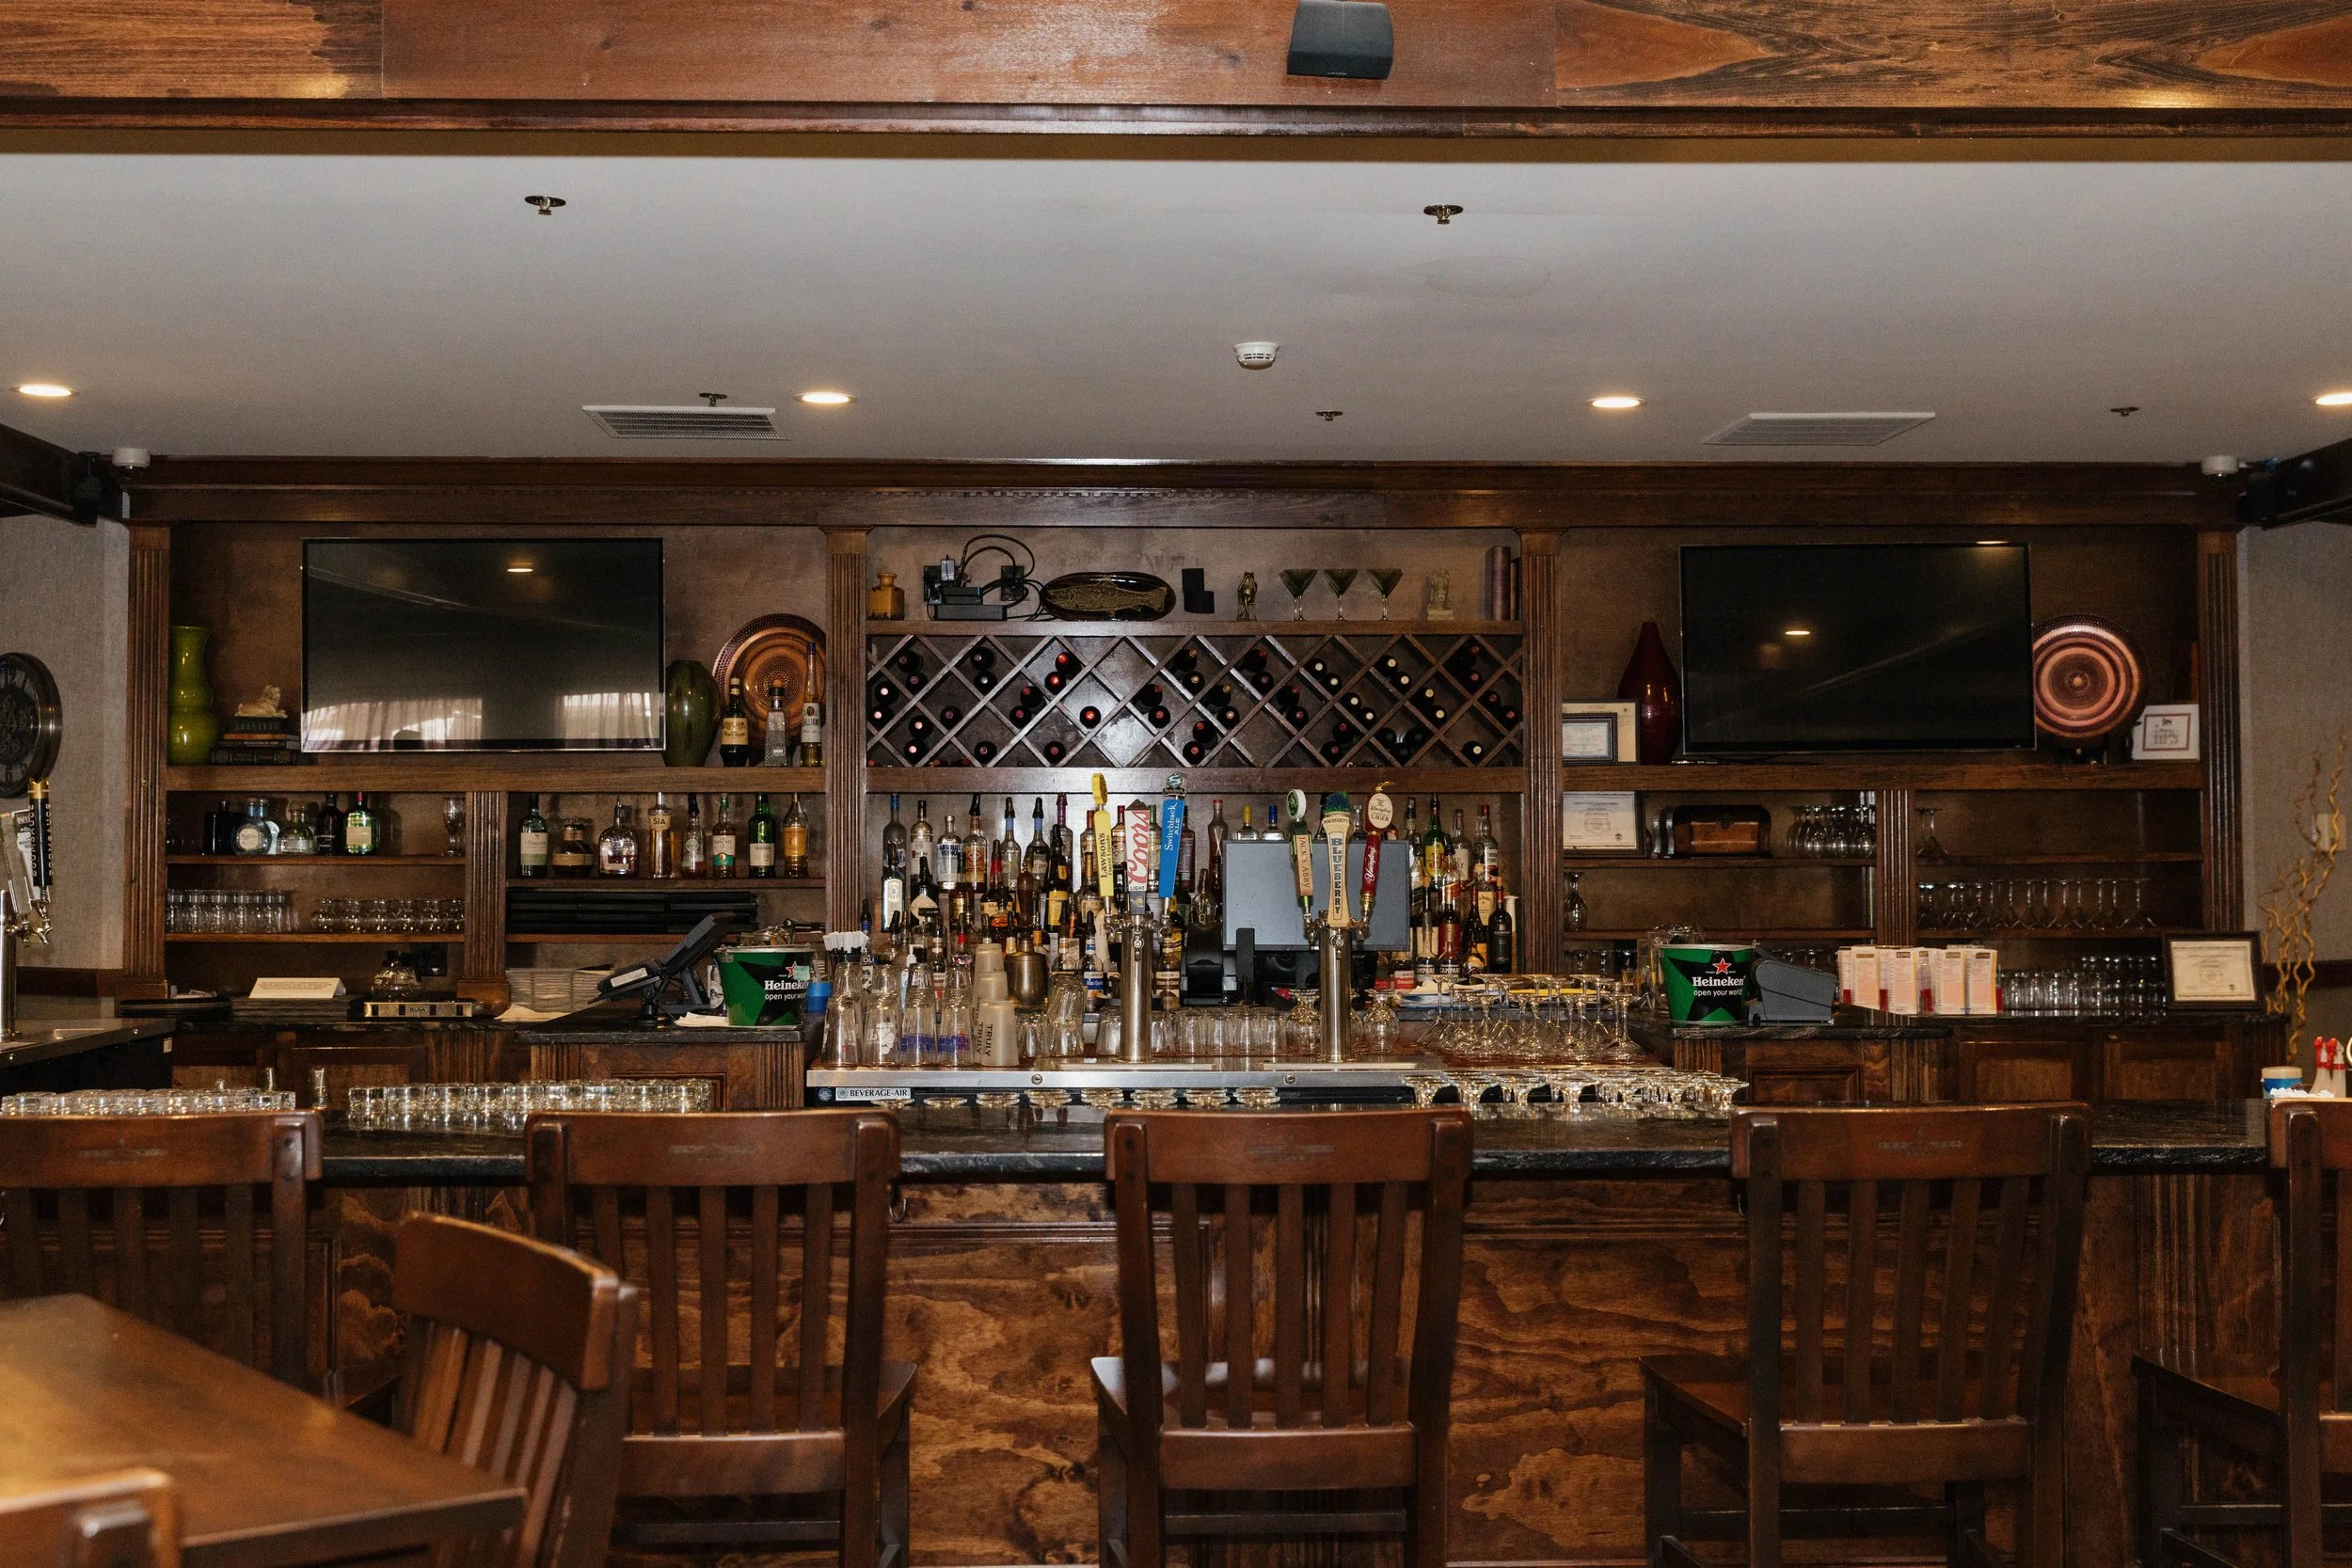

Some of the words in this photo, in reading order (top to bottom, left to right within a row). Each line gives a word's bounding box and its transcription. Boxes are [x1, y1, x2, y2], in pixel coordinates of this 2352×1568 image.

[1164, 801, 1178, 851] Switchback
[1098, 832, 1108, 879] Lawson's
[1127, 810, 1150, 884] Coors
[1297, 836, 1309, 863] JACK'S
[1301, 865, 1311, 889] ABBY
[1330, 837, 1343, 914] BLUEBERRY
[1692, 976, 1744, 987] Heineken
[975, 1022, 984, 1054] TRULY
[984, 1023, 993, 1057] TRULY
[850, 1089, 908, 1098] BEVERAGE-AIR
